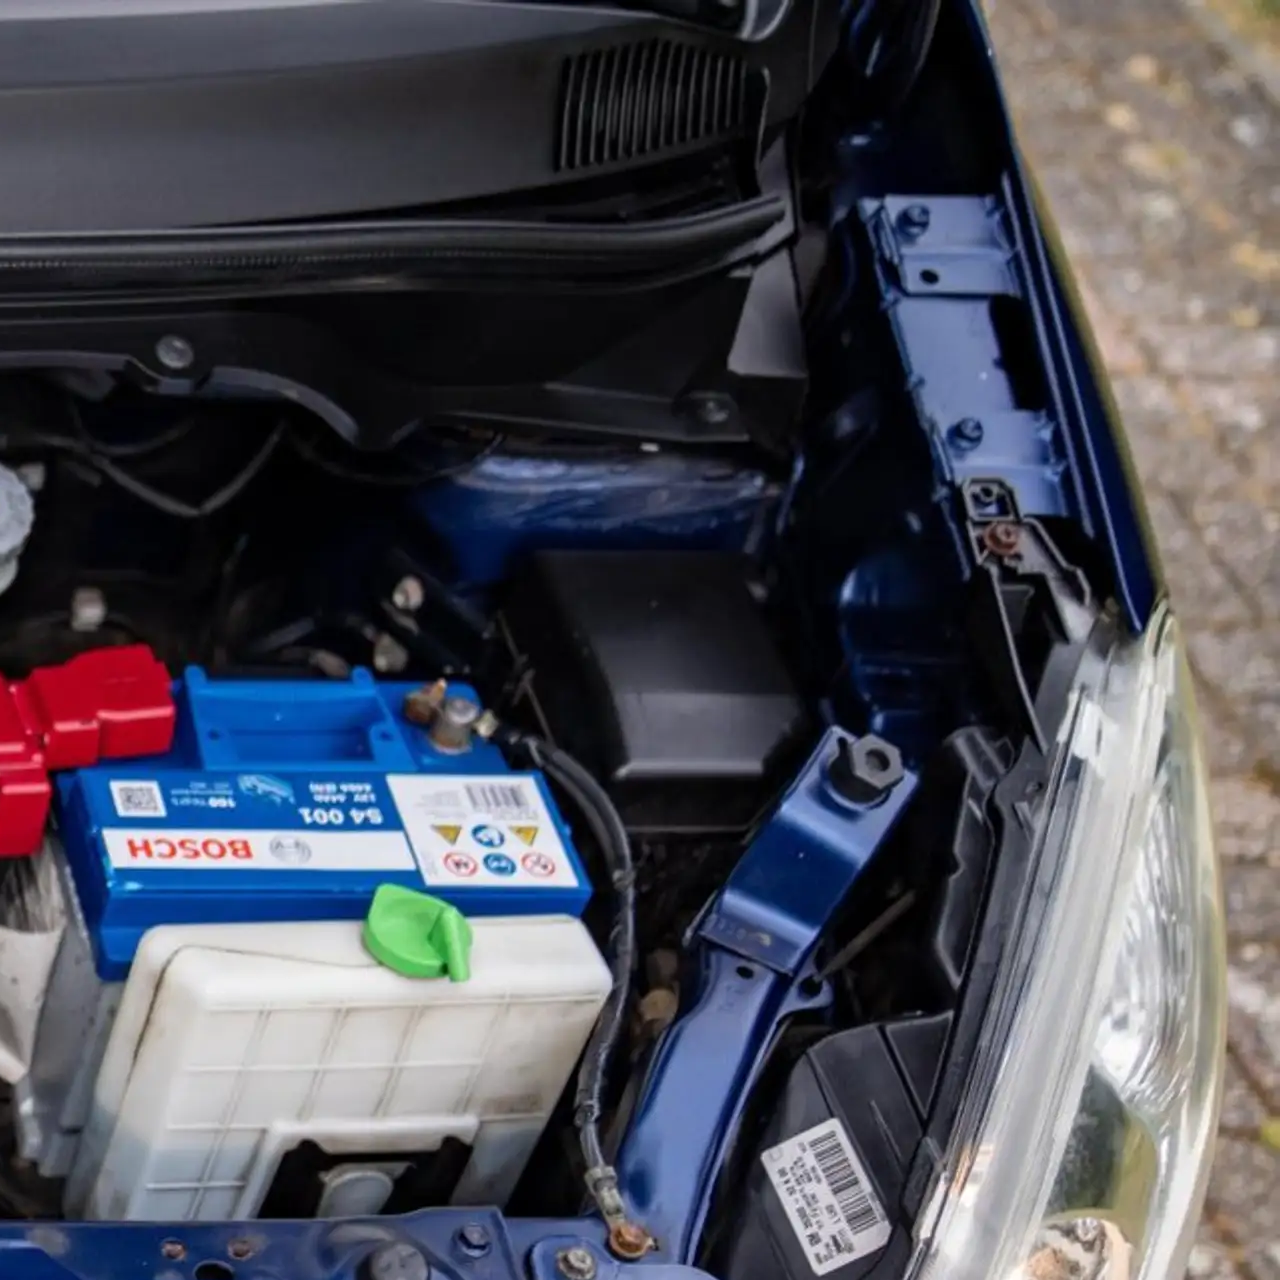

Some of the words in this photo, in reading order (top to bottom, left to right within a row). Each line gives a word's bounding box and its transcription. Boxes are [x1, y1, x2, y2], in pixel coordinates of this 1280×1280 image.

[298, 807, 345, 825] 001
[349, 807, 384, 825] S4
[127, 836, 254, 861] BOSCH
